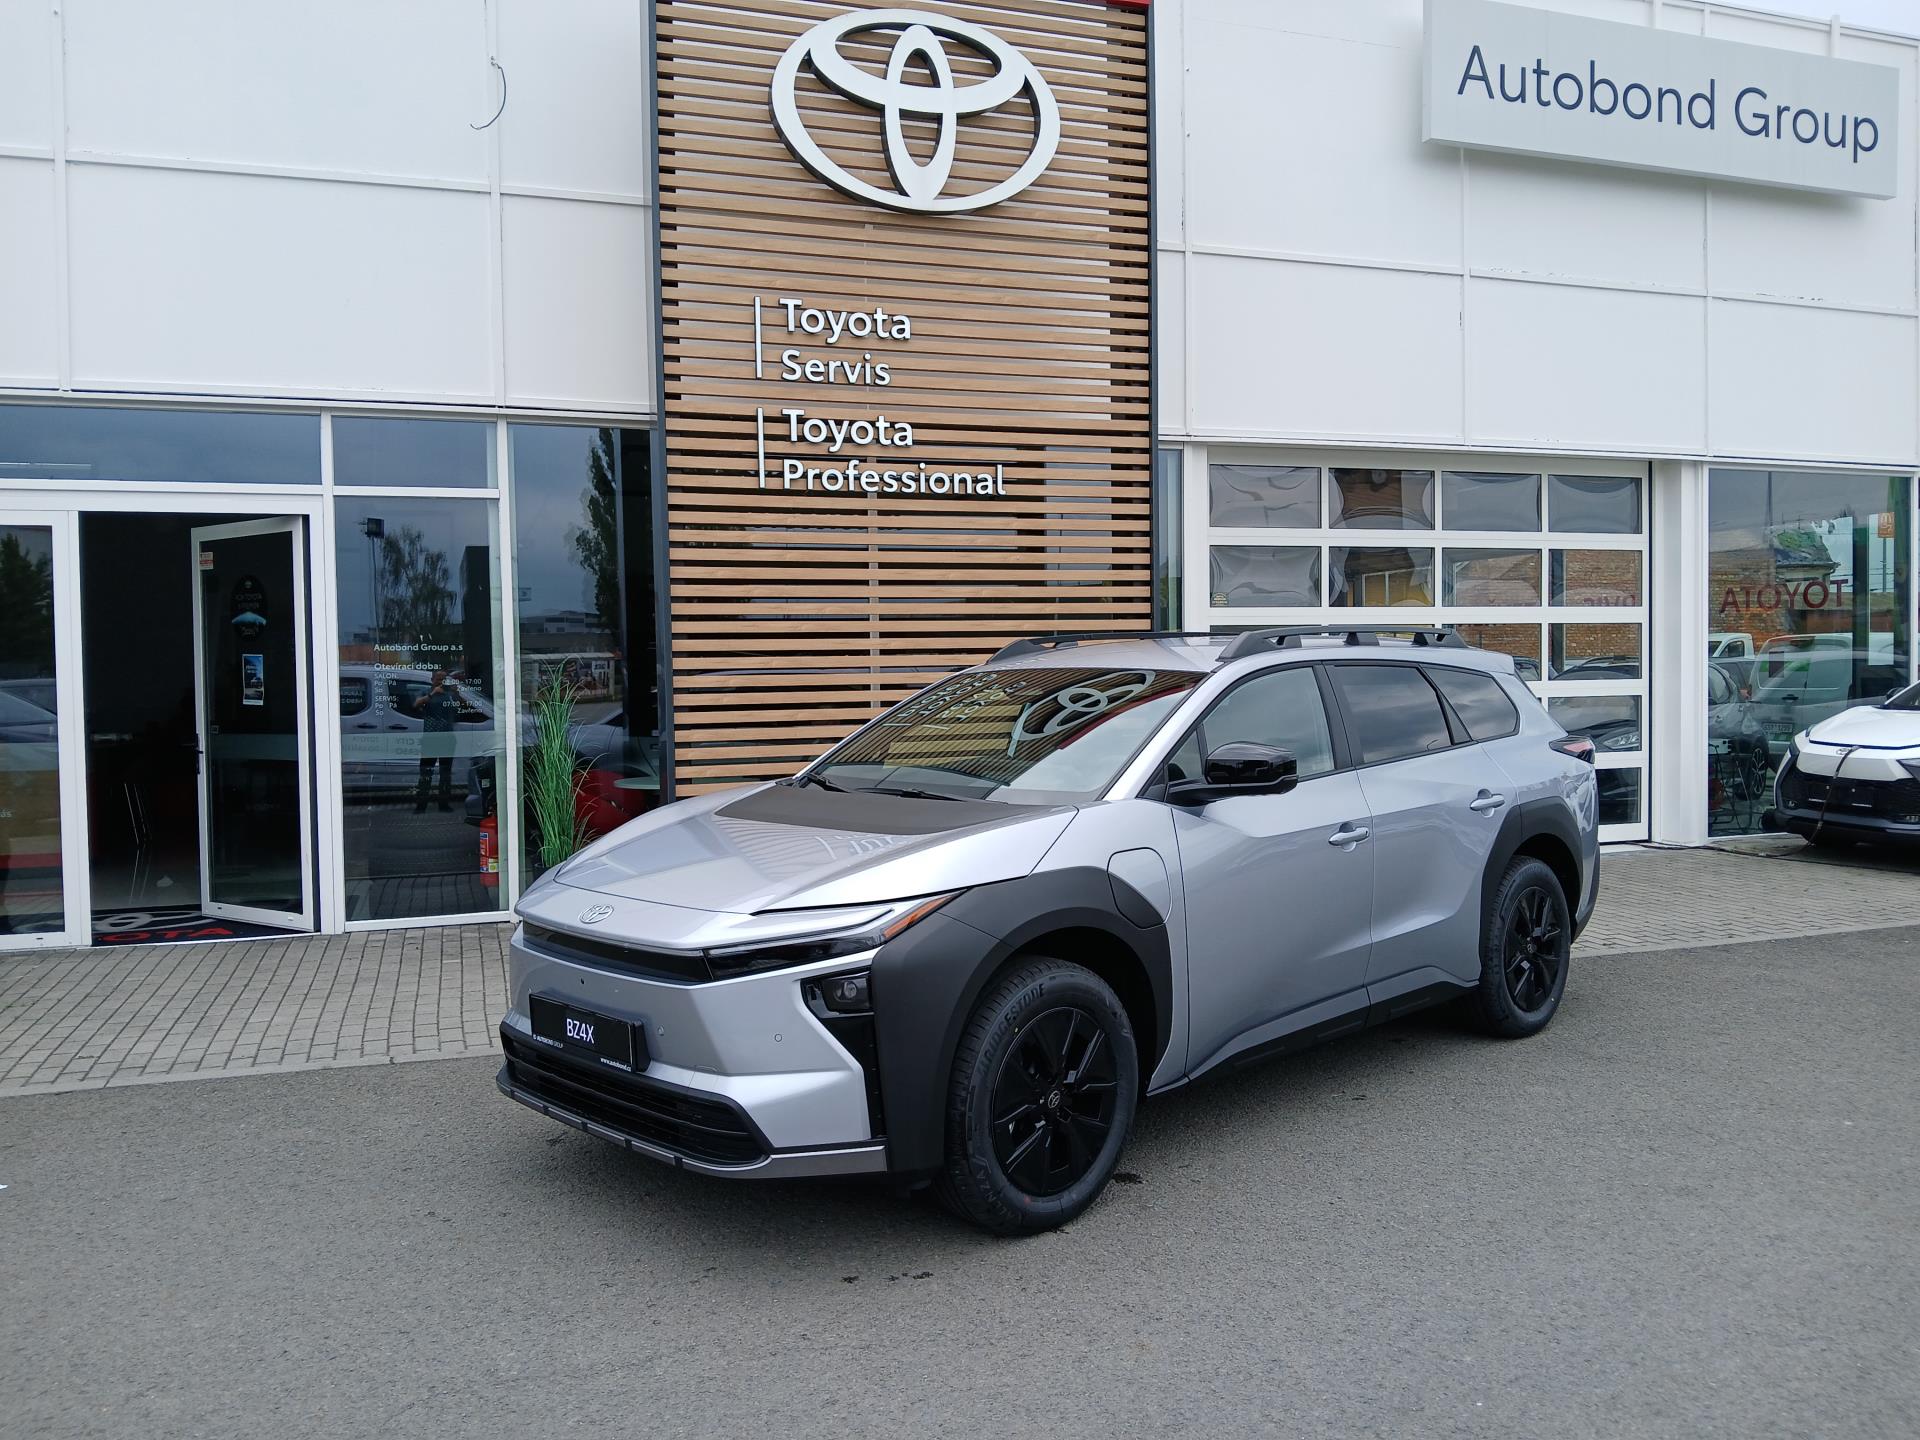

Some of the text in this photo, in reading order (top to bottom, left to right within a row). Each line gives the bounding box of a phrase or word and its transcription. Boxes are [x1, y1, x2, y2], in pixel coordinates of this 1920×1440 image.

[1457, 44, 1879, 163] Autobond Group
[779, 298, 911, 344] Toyota
[781, 349, 891, 386] Servis
[782, 408, 913, 453] Toyota
[783, 458, 1006, 496] Professional
[374, 643, 419, 652] Autobond
[420, 643, 449, 653] Group
[415, 662, 442, 671] doba:
[98, 927, 233, 943] OTA
[566, 1018, 595, 1044] BZ4X
